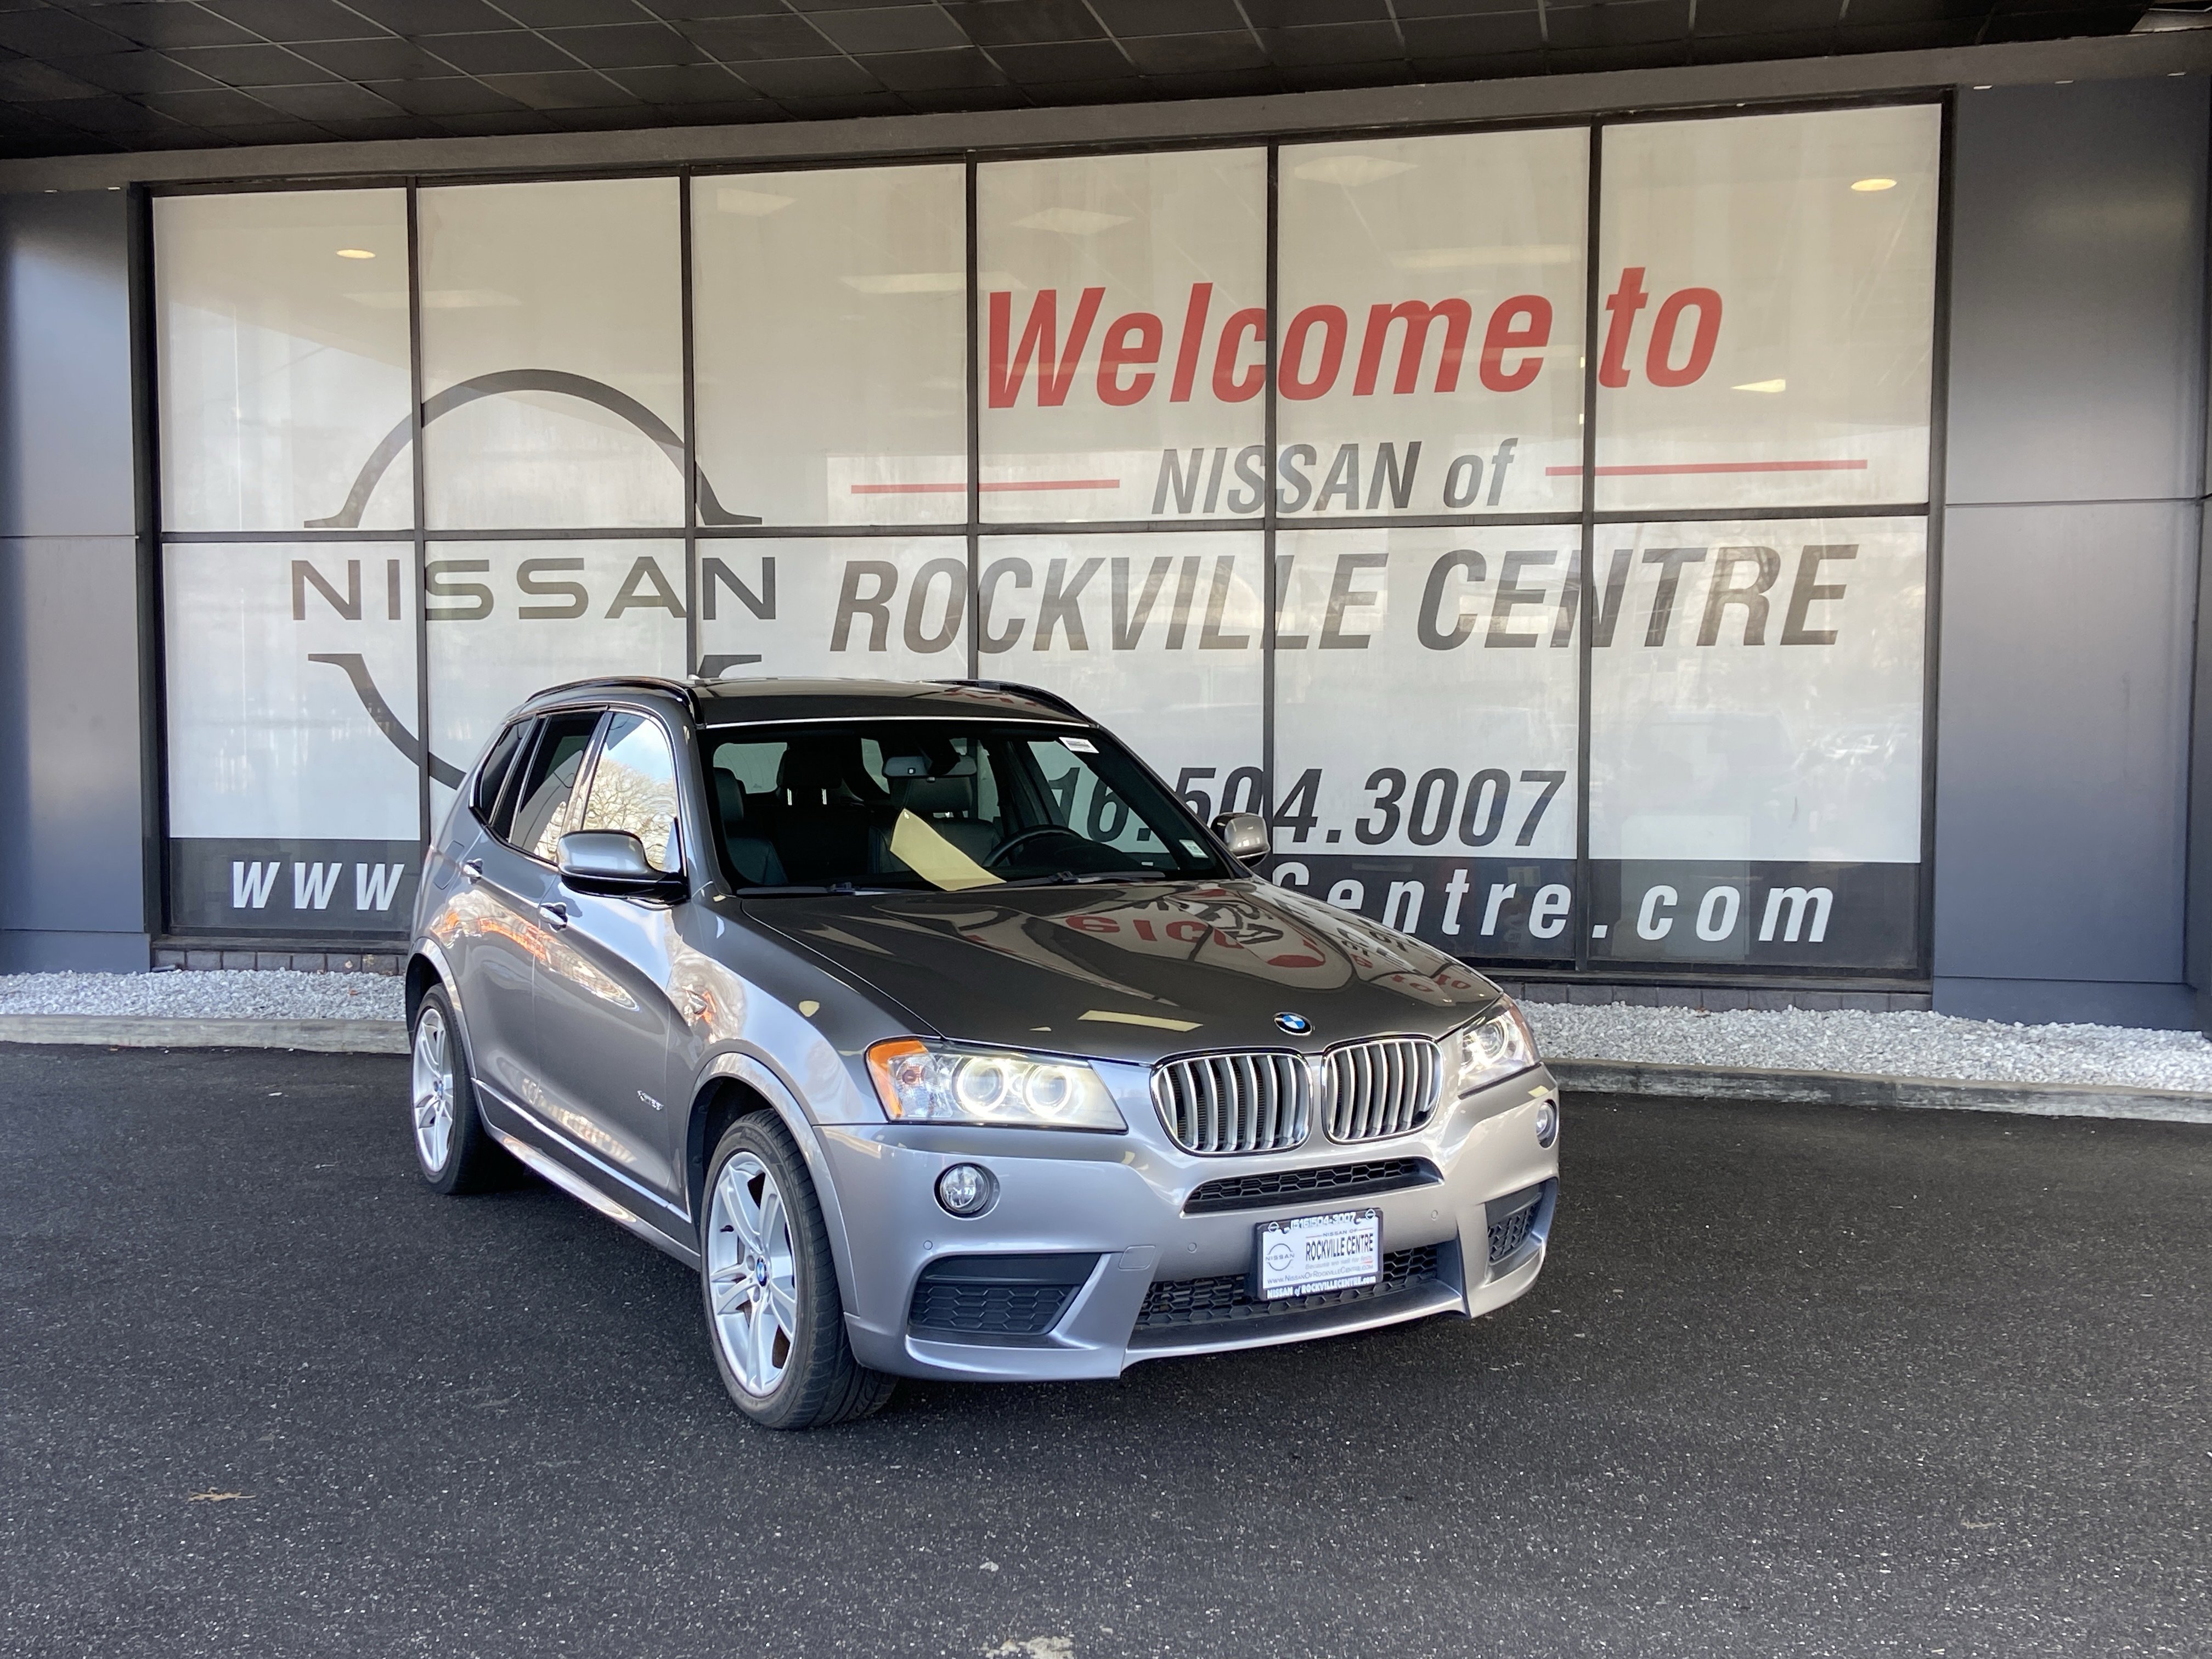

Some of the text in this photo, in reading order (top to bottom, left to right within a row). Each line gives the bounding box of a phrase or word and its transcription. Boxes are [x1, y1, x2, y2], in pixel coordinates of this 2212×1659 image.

[988, 267, 1723, 409] Welcome to
[1152, 437, 1518, 515] NISSAN of
[292, 556, 777, 620] NISSAN
[830, 544, 1858, 654] ROCKVILLE CENTRE
[1266, 1253, 1295, 1261] NISSAN
[1305, 1233, 1373, 1261] ROCKVILLE CENTRE
[1267, 1286, 1293, 1299] NISSAN
